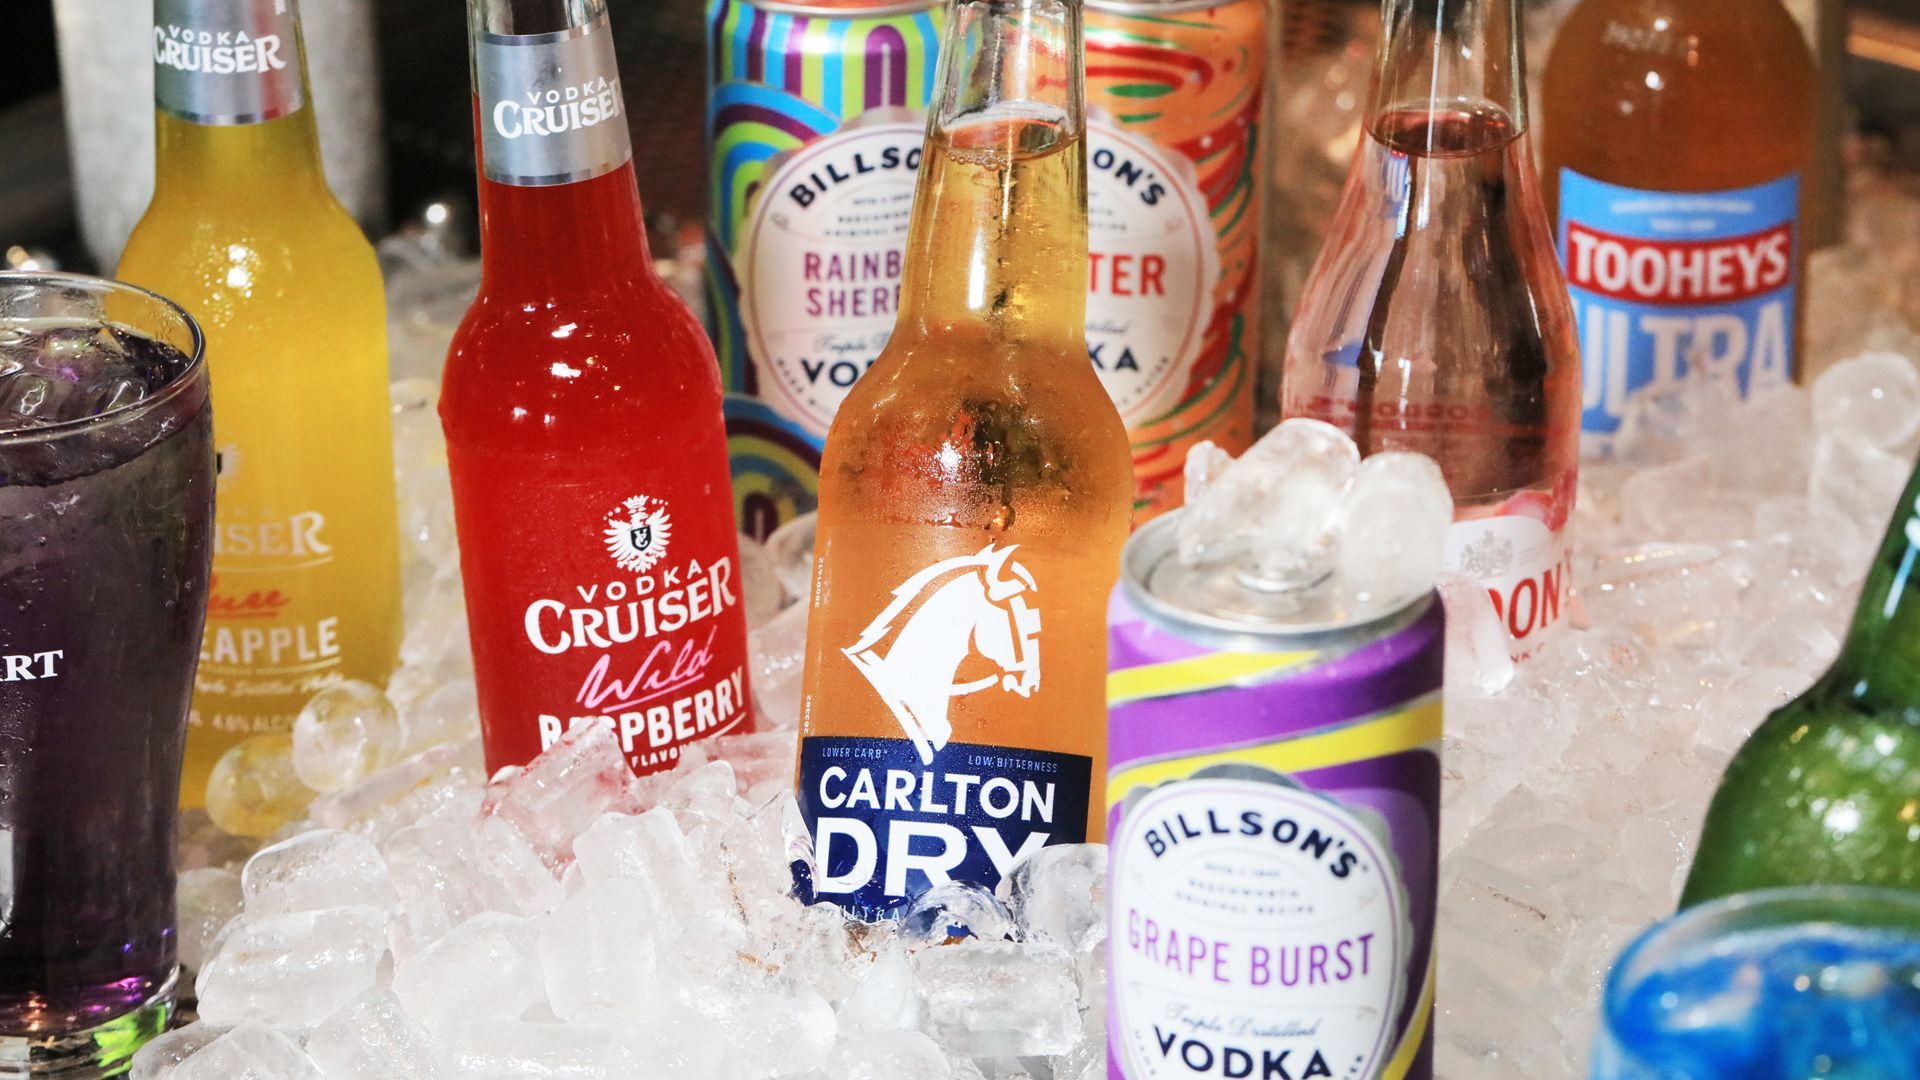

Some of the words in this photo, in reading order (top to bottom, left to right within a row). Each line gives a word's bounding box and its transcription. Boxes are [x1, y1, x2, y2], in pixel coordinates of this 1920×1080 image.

[154, 25, 287, 74] CRUISER
[168, 24, 251, 45] VODKA
[526, 76, 608, 105] VODKA
[1088, 253, 1166, 296] TER
[1570, 230, 1788, 298] TOOHEYS
[801, 359, 875, 387] VO
[524, 556, 736, 654] CRUISER
[576, 559, 702, 603] VODKA
[0, 649, 64, 681] RT
[575, 625, 717, 709] Wild
[538, 686, 743, 753] RPBERRY
[822, 747, 850, 758] LOWER
[967, 754, 993, 766] LOW
[996, 757, 1058, 774] BITTERNESS
[819, 766, 1056, 823] CARLTON
[814, 816, 1052, 898] DRY
[1144, 809, 1358, 879] BILLSON'S
[1128, 907, 1232, 984] GRAPE
[1250, 932, 1375, 986] BURST
[1153, 1024, 1332, 1080] VODKA
